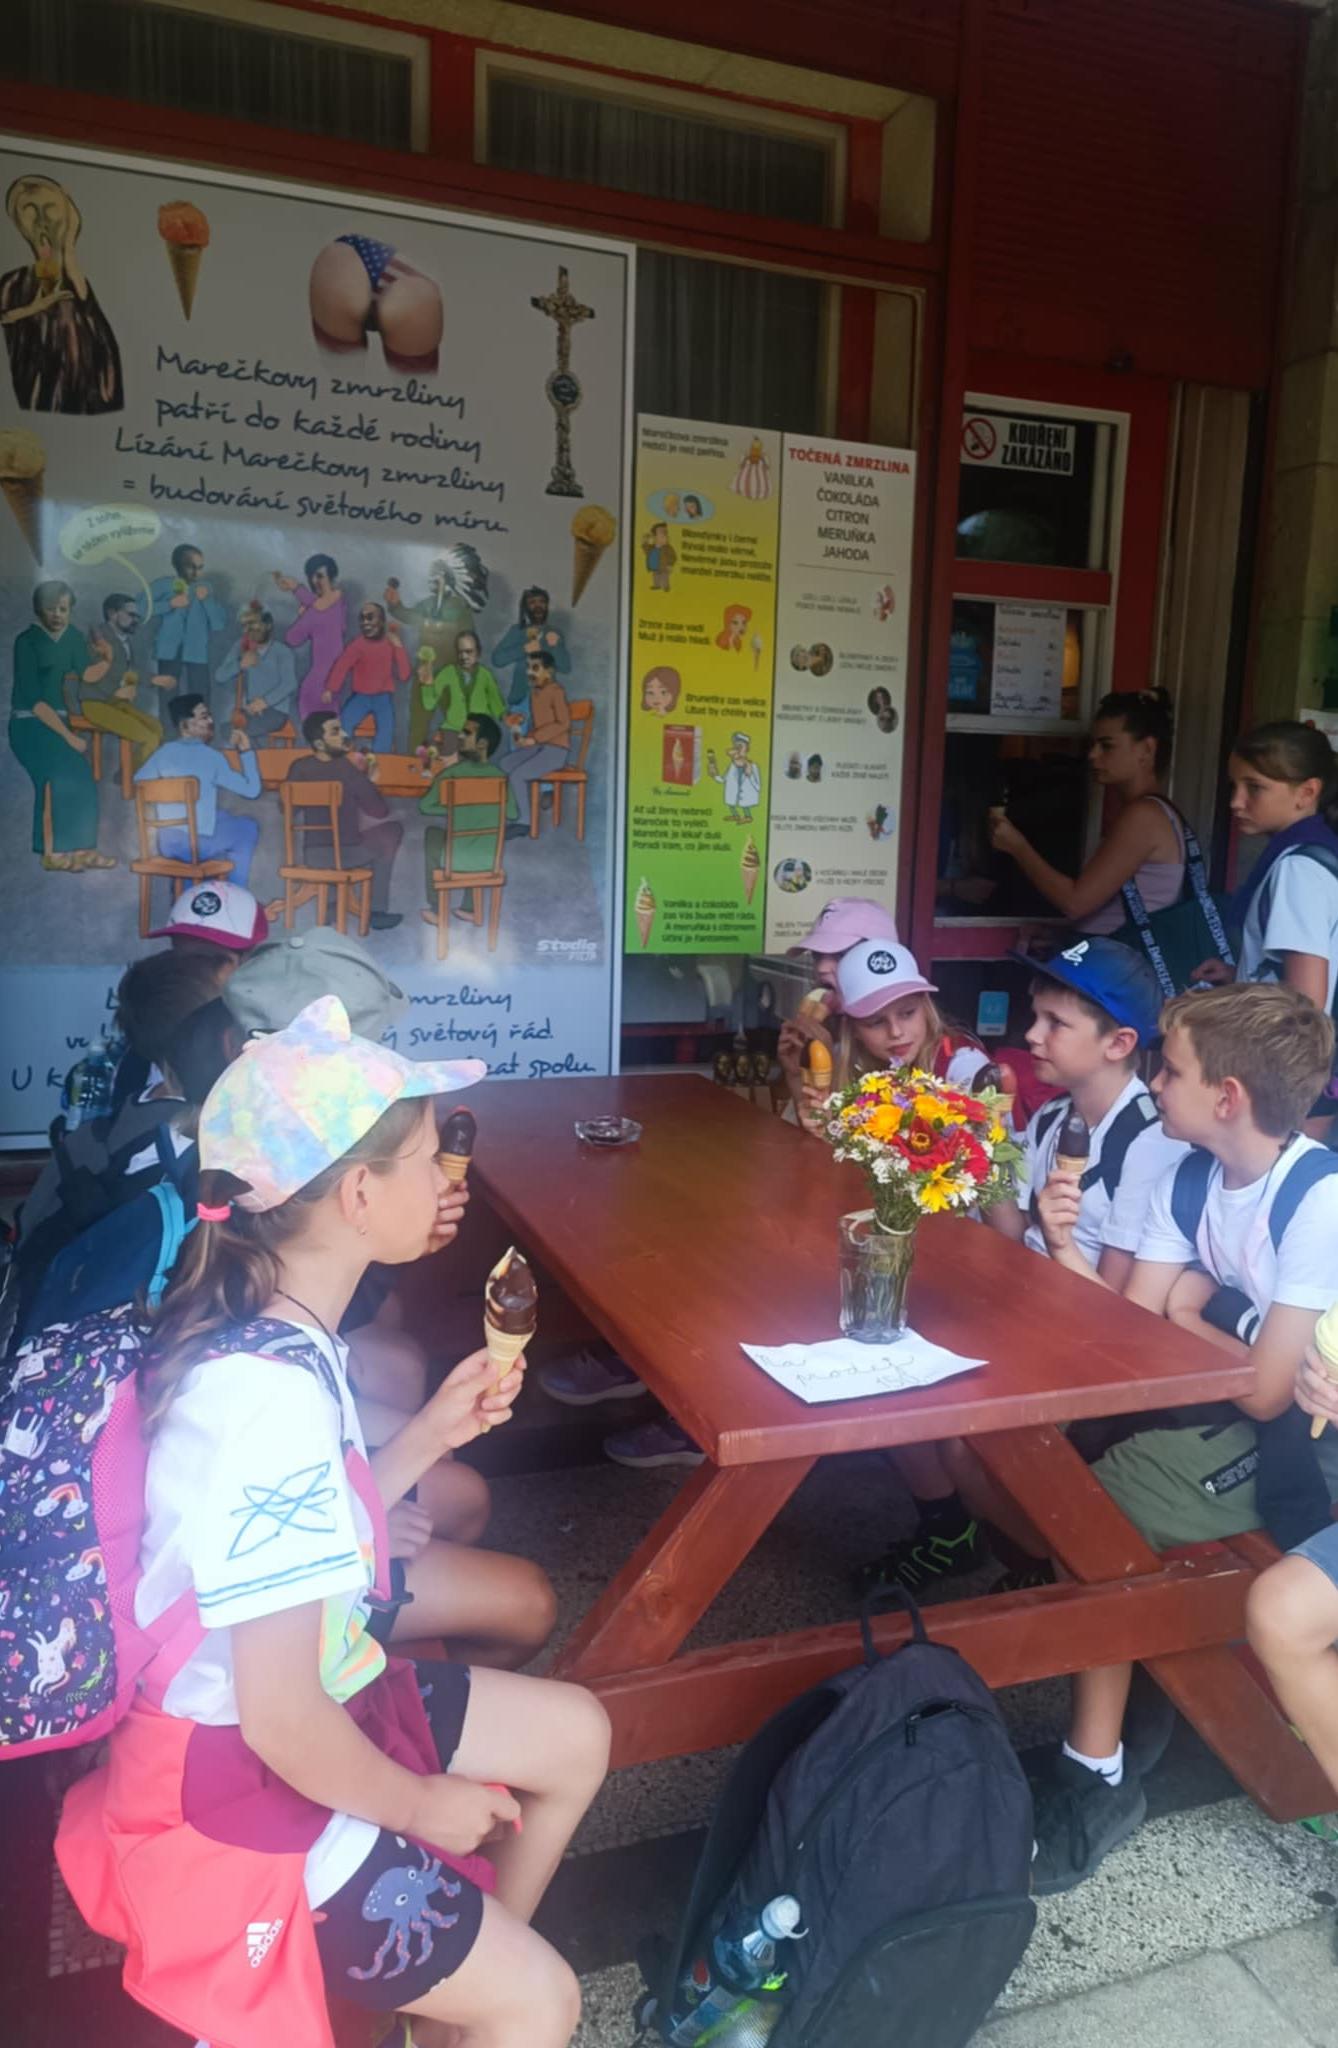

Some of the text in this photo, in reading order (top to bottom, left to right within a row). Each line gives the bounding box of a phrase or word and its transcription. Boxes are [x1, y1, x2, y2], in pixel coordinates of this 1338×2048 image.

[156, 345, 466, 418] Marečkovy zmrzliny
[156, 391, 482, 463] patří do každé rodiny
[116, 428, 506, 503] Lízání Marečkovy zmrzliny
[789, 448, 910, 474] TOČENÁ ZMRZLINA
[824, 472, 874, 489] VANILKA
[150, 474, 288, 512] budování
[297, 493, 423, 527] světového
[435, 514, 509, 533] míru
[817, 487, 879, 507] ČOKOLÁDA
[826, 509, 869, 525] CITRON
[817, 527, 876, 544] MERUŇKA
[822, 546, 869, 561] JAHODA
[408, 985, 512, 1012] mrzliny
[409, 1017, 497, 1048] světový
[11, 1064, 32, 1091] U
[529, 1052, 596, 1078] spolu
